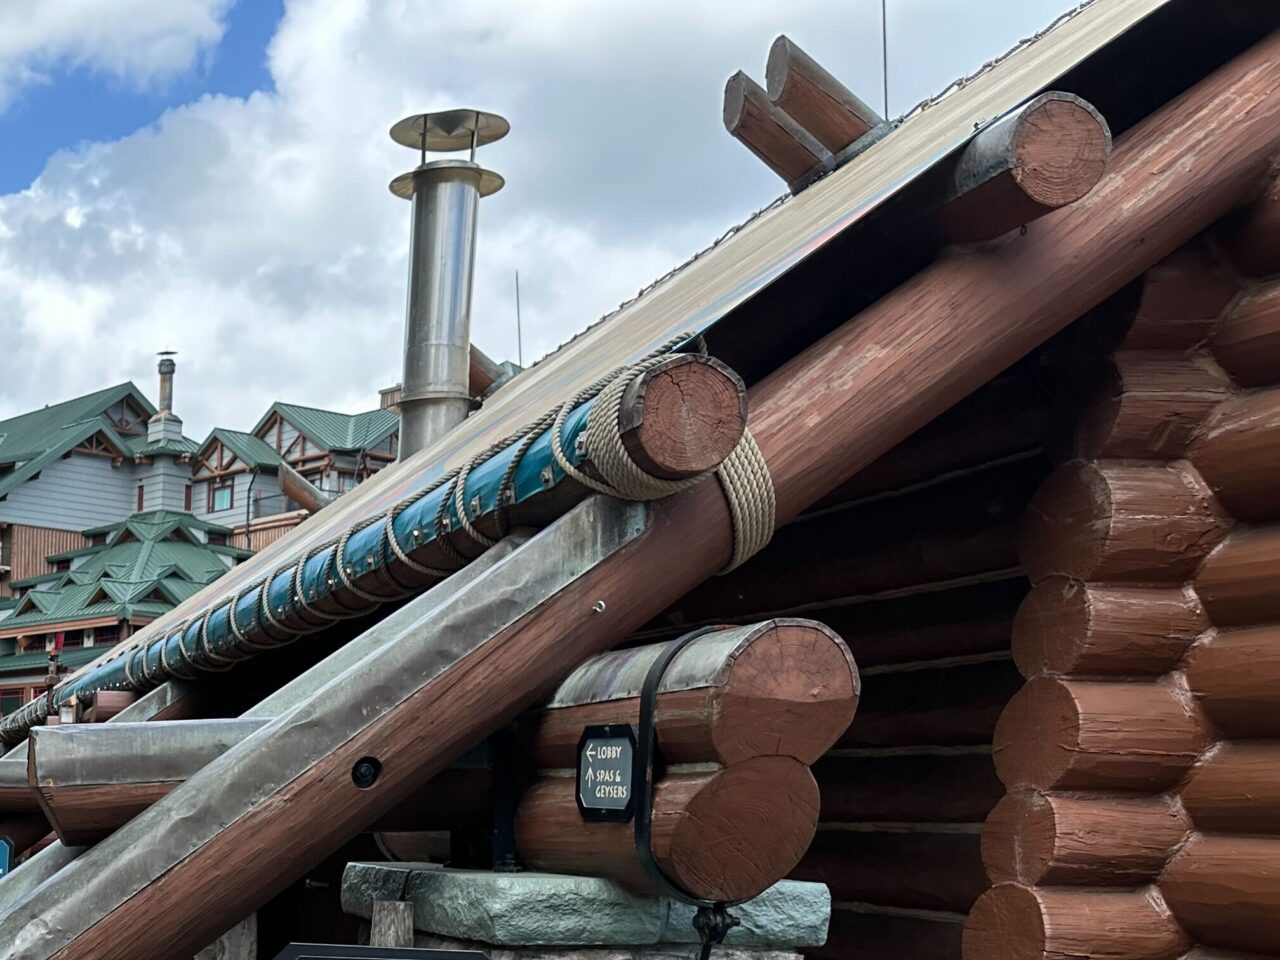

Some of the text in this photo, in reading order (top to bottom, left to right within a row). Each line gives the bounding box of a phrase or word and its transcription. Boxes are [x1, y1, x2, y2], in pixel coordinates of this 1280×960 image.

[597, 746, 622, 759] LOBBY
[596, 769, 621, 782] SPAS &
[595, 785, 627, 798] GEYSERS
